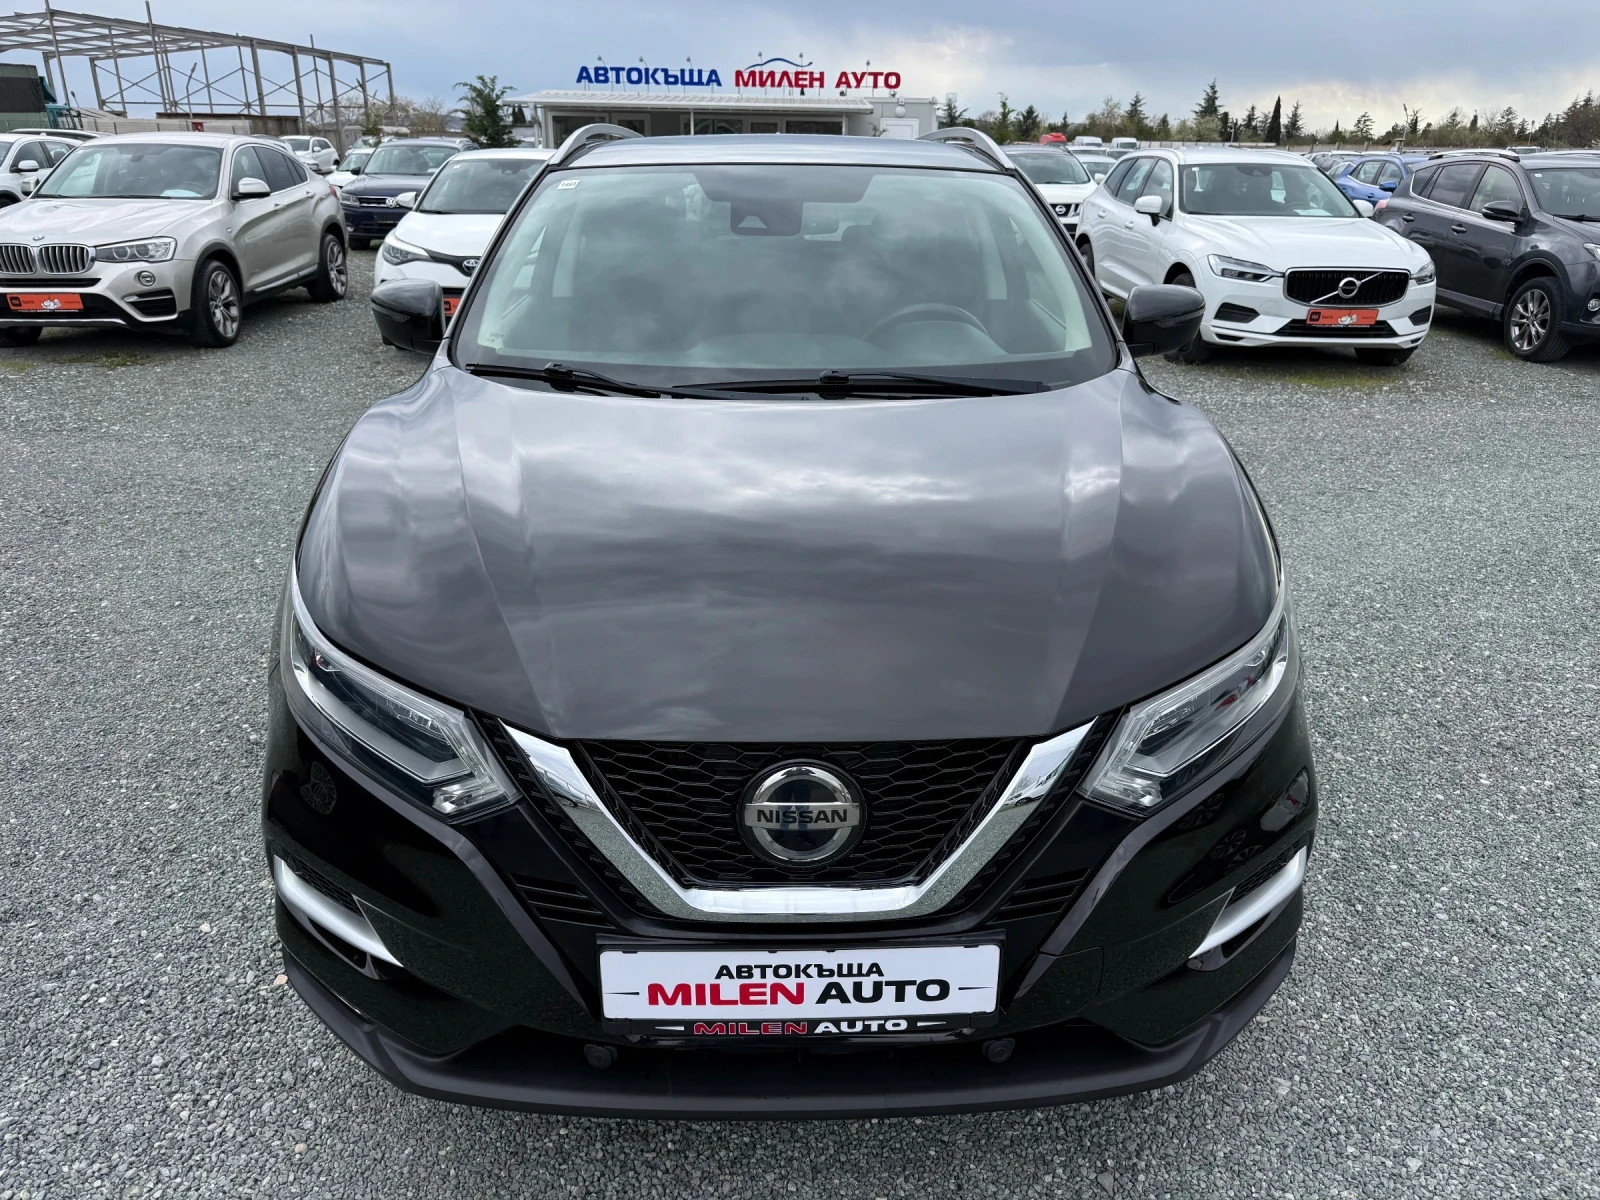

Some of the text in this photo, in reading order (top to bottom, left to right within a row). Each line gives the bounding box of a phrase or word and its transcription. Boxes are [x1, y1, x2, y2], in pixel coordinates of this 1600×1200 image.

[576, 66, 901, 89] АВТОКЪЩА МИЛЕН АУТО
[757, 809, 848, 824] NISSAN
[714, 962, 885, 980] АВТОКЪЩА
[647, 978, 951, 1006] MILEN AUTO
[693, 1019, 908, 1035] MILEN AUTO
